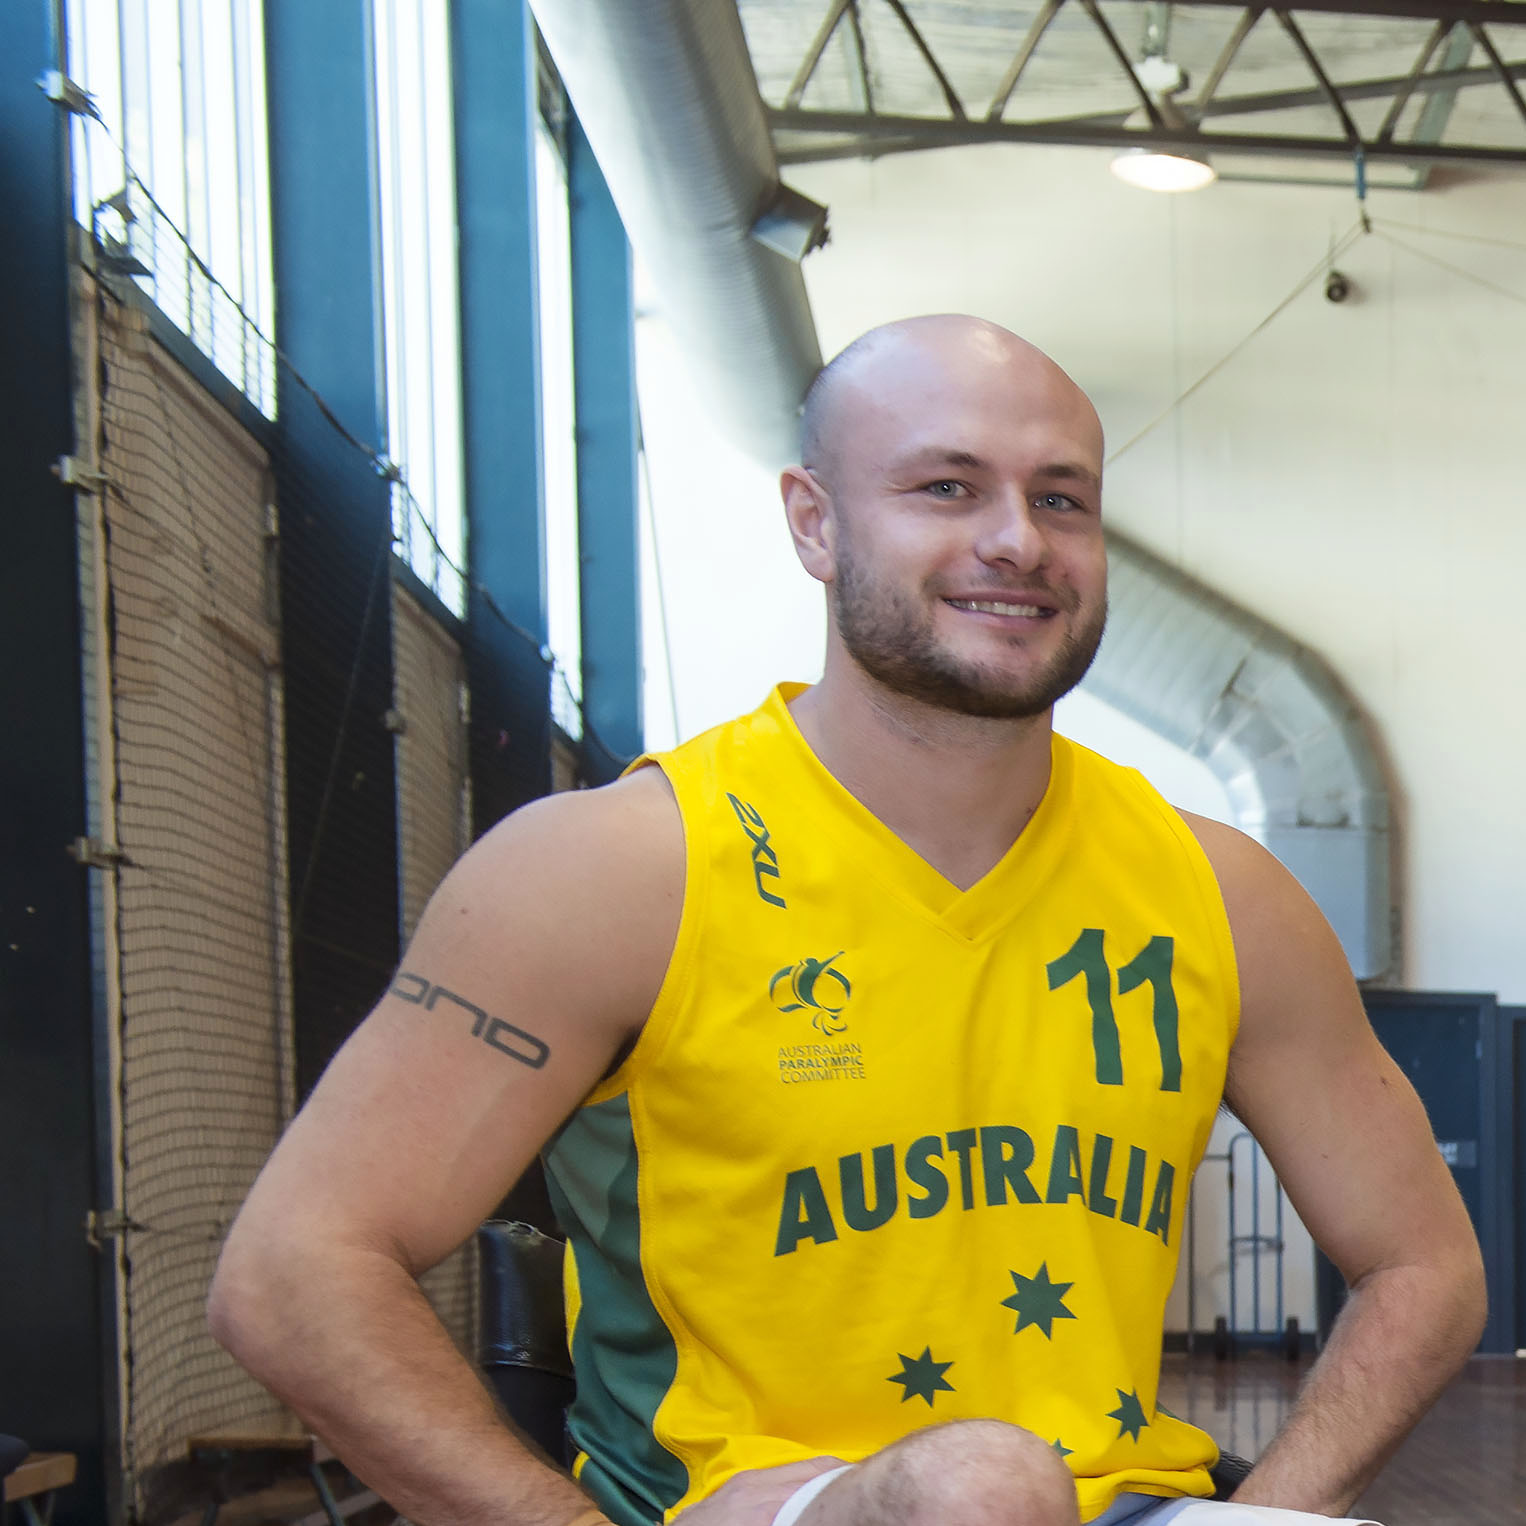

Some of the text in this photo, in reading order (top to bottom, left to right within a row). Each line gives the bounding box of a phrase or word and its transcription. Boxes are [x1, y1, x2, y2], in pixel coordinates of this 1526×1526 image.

[727, 792, 787, 909] 2XU
[1046, 928, 1182, 1093] 11
[778, 1043, 862, 1058] AUSTRALIAN
[779, 1055, 865, 1070] PARALYMPIC
[781, 1066, 866, 1084] COMMITTEE
[774, 1124, 1176, 1257] AUSTRALIA
